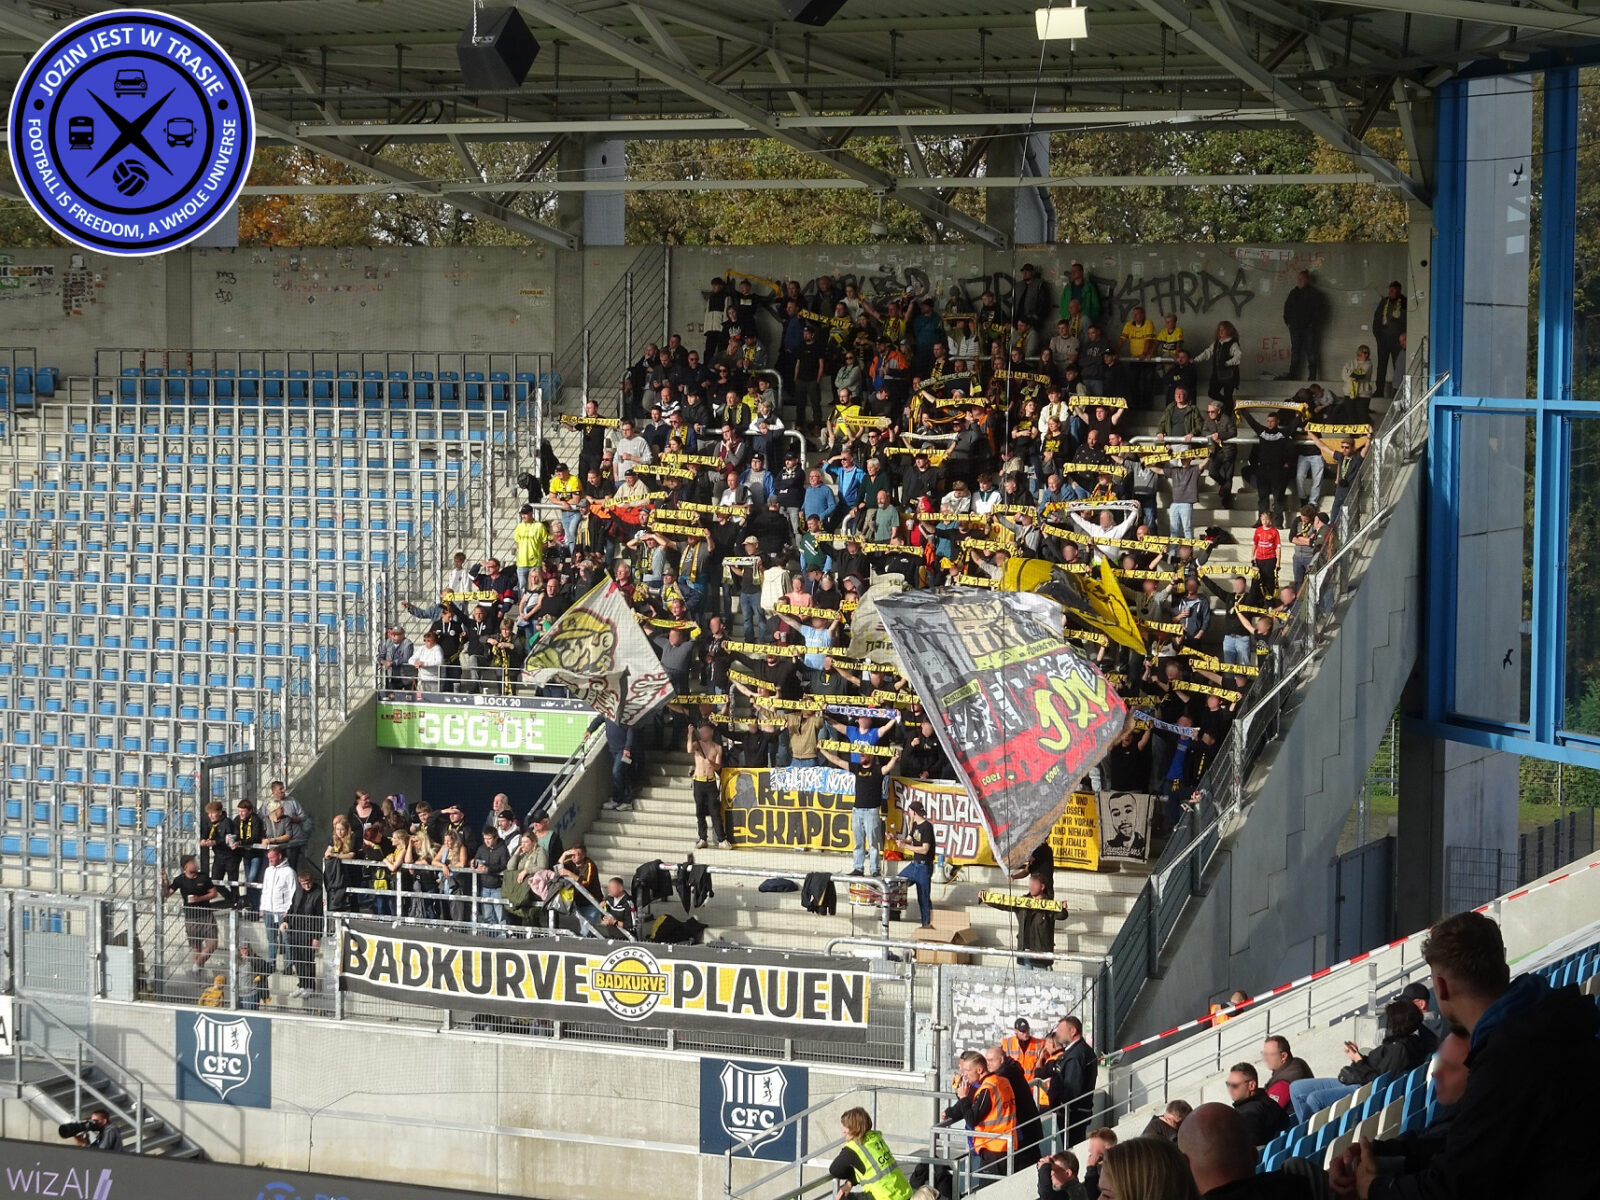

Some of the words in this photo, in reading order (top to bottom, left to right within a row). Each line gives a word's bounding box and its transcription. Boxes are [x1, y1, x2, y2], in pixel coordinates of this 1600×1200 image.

[509, 696, 521, 707] 20
[420, 711, 545, 750] GGG.DE
[608, 950, 645, 966] BLOCK
[342, 931, 588, 1004] BADKURVE
[672, 963, 867, 1023] PLAUEN
[594, 972, 667, 993] BADKURVE
[608, 997, 653, 1015] PLAUEN
[203, 1055, 242, 1076] CFC
[730, 1106, 775, 1129] CFC
